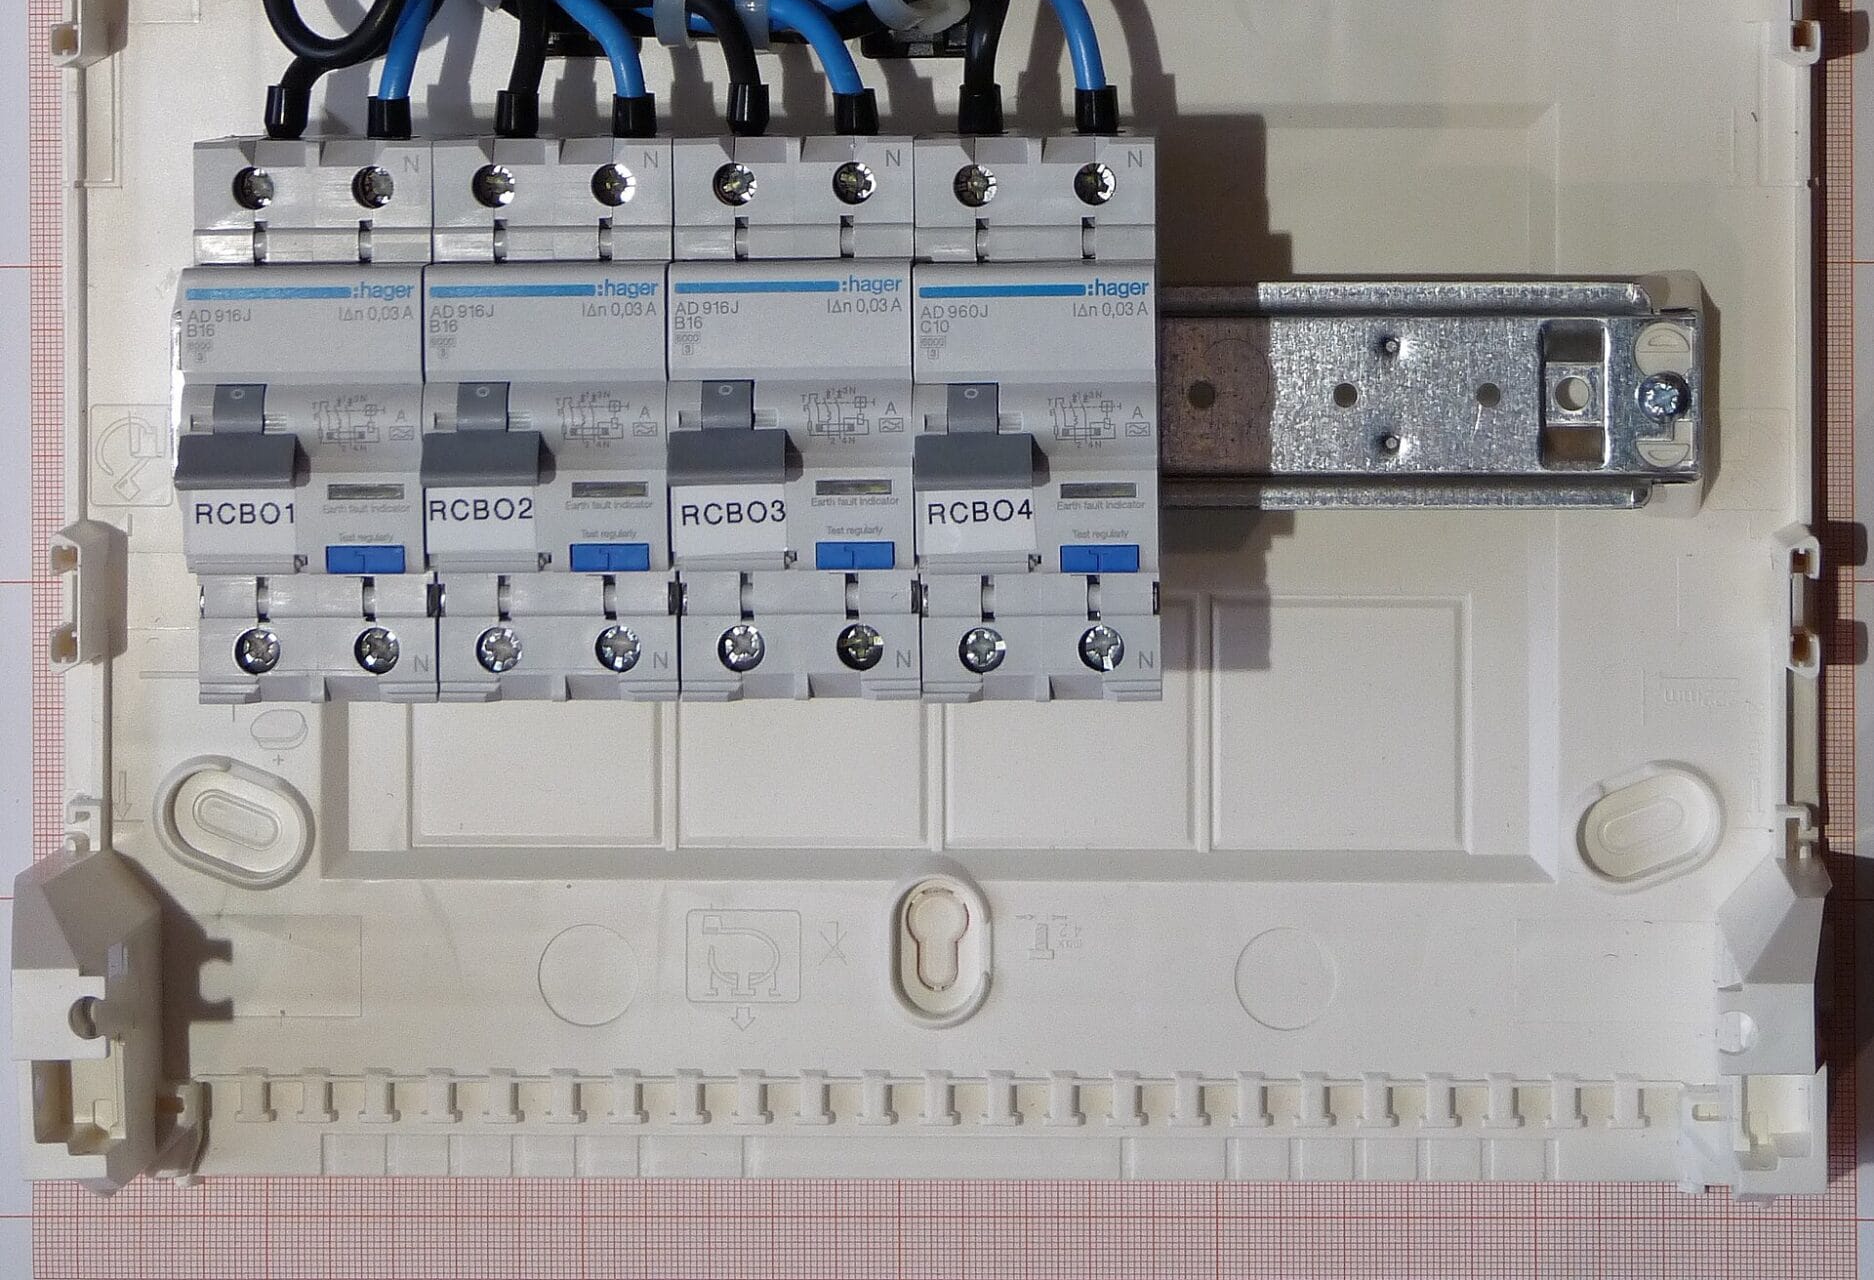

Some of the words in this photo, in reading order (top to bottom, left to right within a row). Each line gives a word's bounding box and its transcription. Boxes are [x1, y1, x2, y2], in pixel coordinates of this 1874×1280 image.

[404, 155, 419, 172] N
[644, 151, 657, 168] N
[886, 150, 900, 166] N
[1128, 150, 1142, 167] N
[430, 320, 458, 333] B16
[674, 317, 703, 329] B16
[921, 320, 949, 333] C10
[186, 325, 215, 337] B16
[639, 407, 650, 418] A
[885, 402, 896, 414] A
[1132, 406, 1143, 418] A
[396, 410, 406, 422] A
[429, 498, 533, 520] RCBO2
[811, 497, 834, 507] Earth
[837, 497, 857, 506] fault
[860, 497, 899, 506] indicator
[1057, 500, 1081, 510] Earth
[1084, 500, 1104, 509] fault
[1107, 500, 1145, 509] indicator
[195, 503, 294, 524] RCBO1
[682, 499, 786, 525] RCBO3
[928, 498, 1033, 524] RCBO4
[827, 526, 843, 535] Test
[845, 526, 883, 536] regularly
[1072, 530, 1089, 538] Test
[1091, 529, 1129, 539] regularly
[414, 655, 428, 672] N
[654, 652, 667, 668] N
[897, 651, 910, 668] N
[1139, 652, 1152, 668] N
